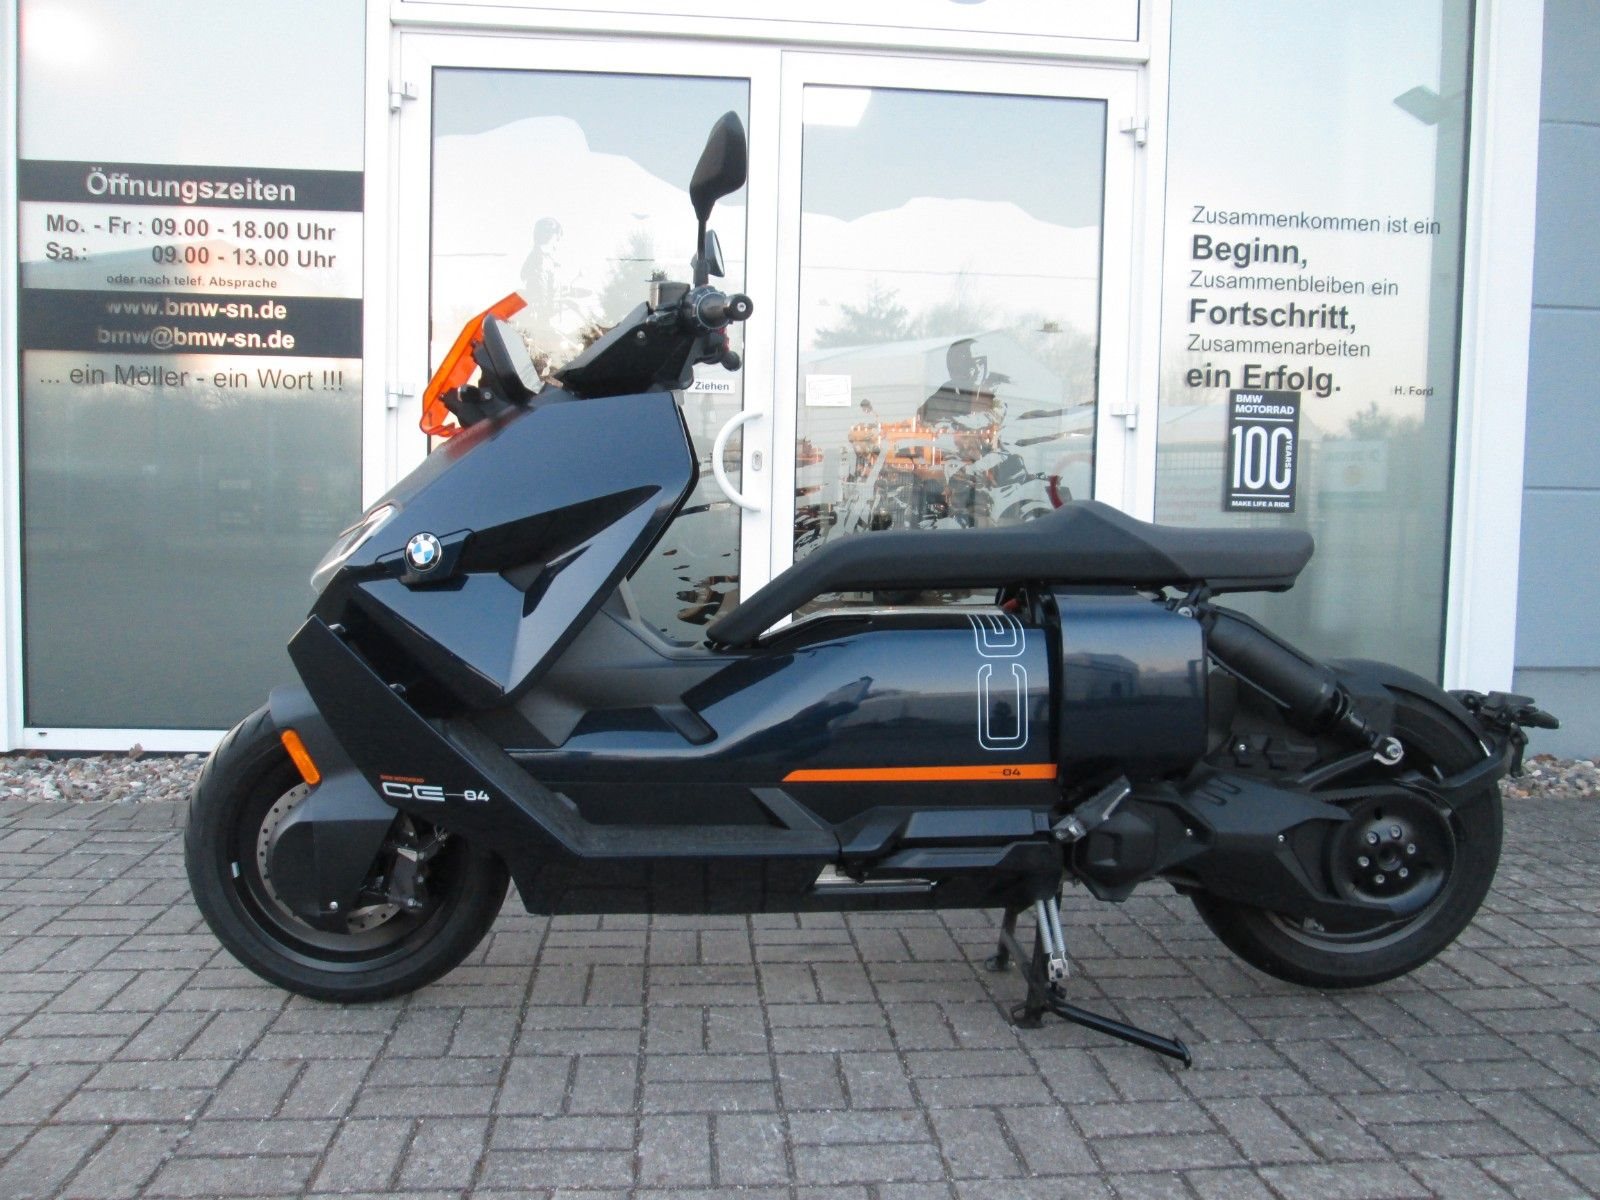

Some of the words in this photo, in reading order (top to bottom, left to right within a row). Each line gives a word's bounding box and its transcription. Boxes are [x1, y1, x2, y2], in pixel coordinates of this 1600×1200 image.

[86, 167, 296, 203] Öffnungszeiten
[46, 213, 86, 233] Mo.
[151, 217, 209, 237] 09.00
[232, 220, 289, 239] 18.00
[297, 222, 336, 241] Uhr
[1192, 205, 1380, 233] Zusammenkommen
[1387, 215, 1408, 234] ist
[1413, 218, 1441, 235] ein
[152, 245, 210, 264] 09.00
[232, 248, 289, 267] 13.00
[298, 249, 336, 268] Uhr
[1192, 233, 1308, 268] Beginn,
[106, 274, 136, 284] oder
[139, 275, 170, 285] nach
[174, 275, 205, 287] telef.
[209, 276, 278, 290] Absprache
[1189, 270, 1365, 295] Zusammenbleiben
[1371, 279, 1399, 296] ein
[107, 298, 287, 319] www.bmw-sn.de
[1189, 298, 1356, 334] Fortschritt,
[97, 326, 295, 349] bmw@bmw-sn.de
[1187, 333, 1371, 358] Zusammenarbeiten
[70, 364, 105, 385] ein
[115, 364, 189, 386] Möller
[214, 368, 248, 388] ein
[257, 368, 314, 390] Wort
[695, 381, 730, 391] Ziehen
[1186, 363, 1231, 388] ein
[1243, 363, 1341, 398] Erfolg.
[1235, 394, 1263, 403] BMW
[1394, 386, 1407, 396] H.
[1409, 386, 1434, 397] Ford
[1235, 404, 1295, 415] MOTORRAD
[1232, 425, 1293, 490] 100
[1285, 438, 1293, 469] YEARS
